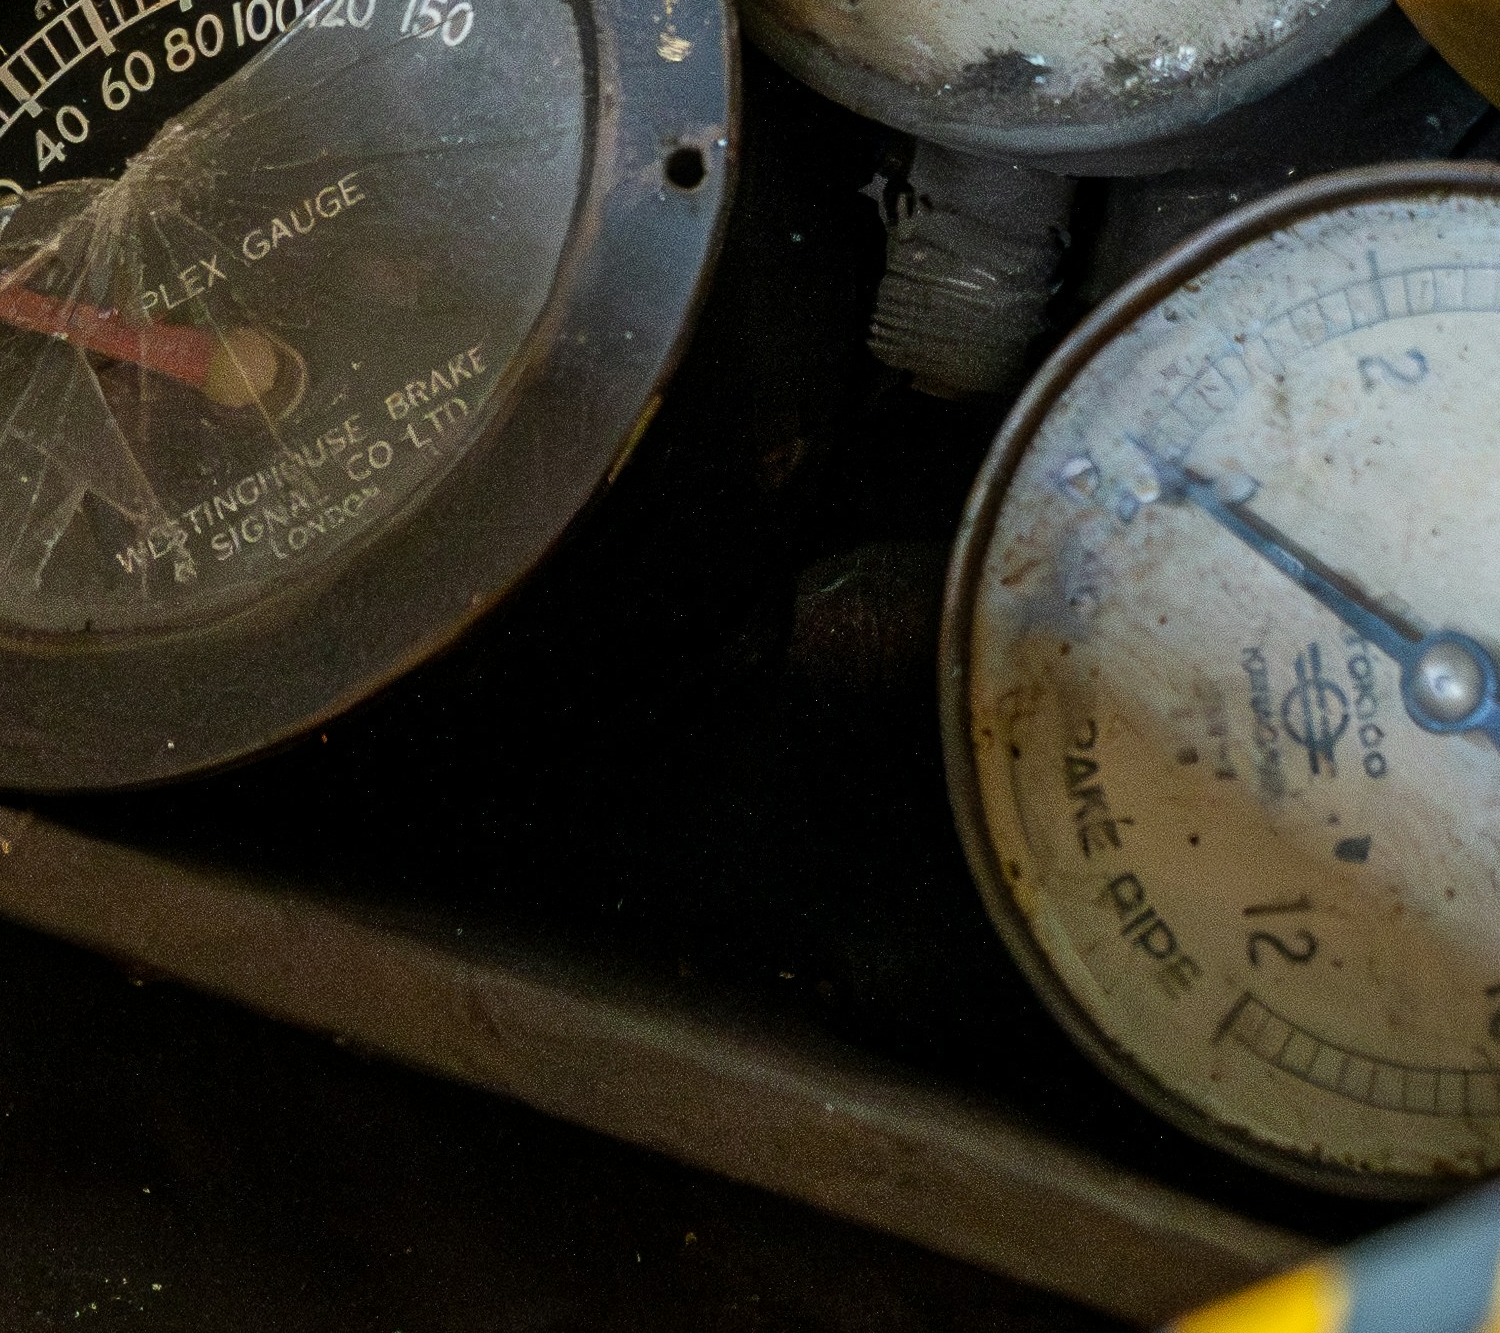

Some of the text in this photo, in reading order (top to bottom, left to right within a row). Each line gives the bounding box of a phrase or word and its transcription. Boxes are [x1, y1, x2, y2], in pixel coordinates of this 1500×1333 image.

[35, 105, 90, 173] 40
[100, 50, 155, 113] 60
[164, 13, 224, 74] 80
[242, 171, 367, 261] GAUGE
[384, 344, 488, 421] BRAKE
[1357, 348, 1430, 392] 2
[1242, 891, 1319, 967] 12
